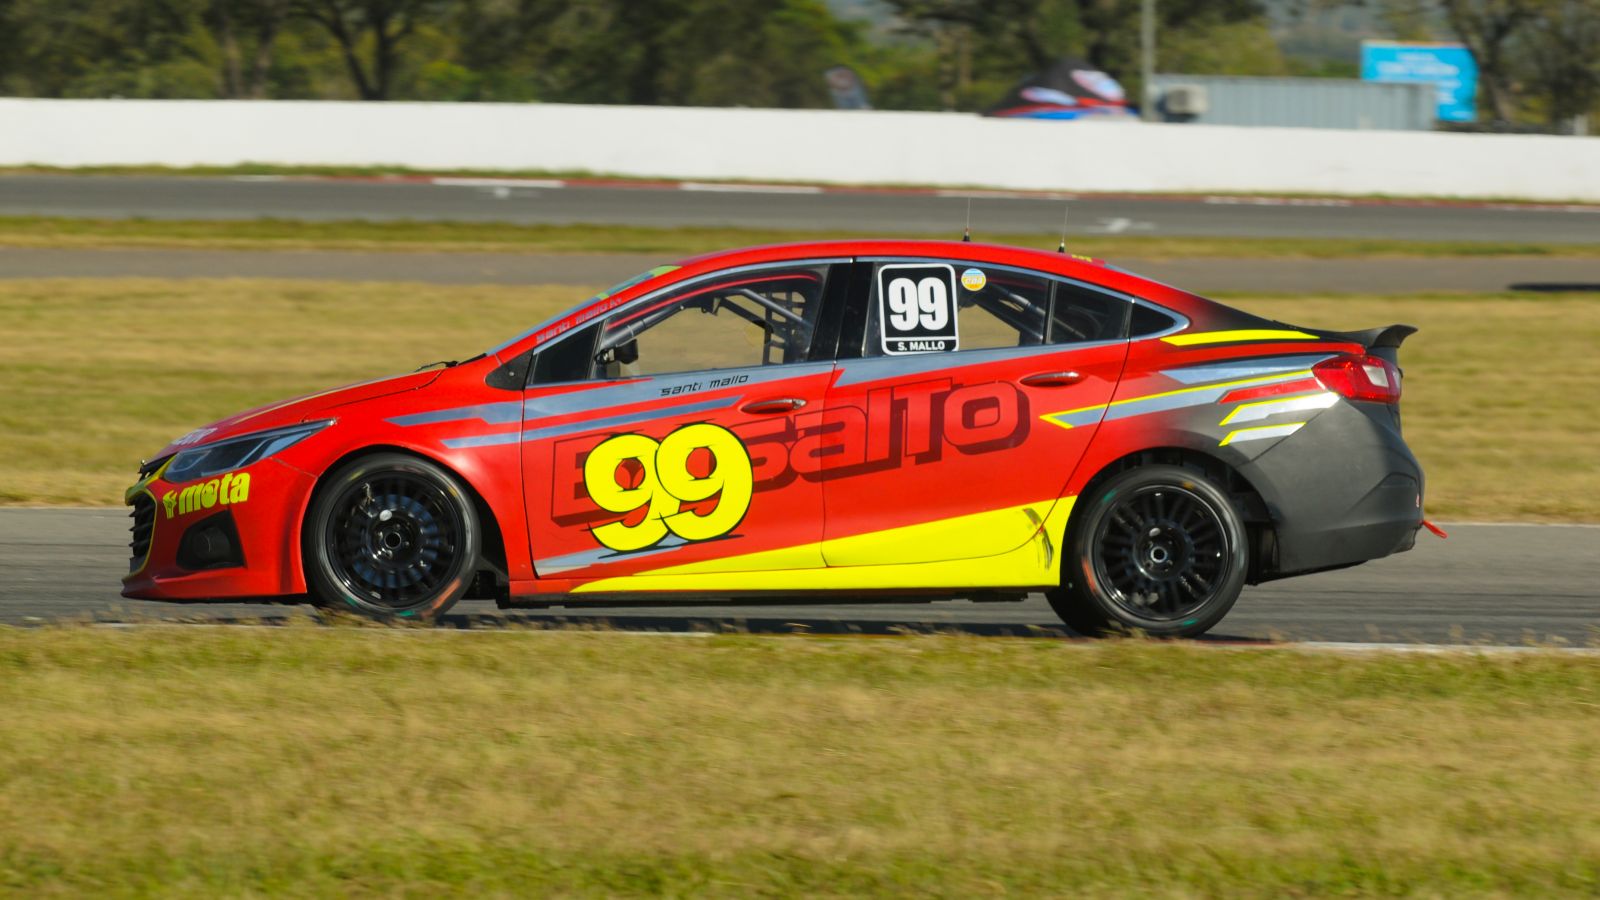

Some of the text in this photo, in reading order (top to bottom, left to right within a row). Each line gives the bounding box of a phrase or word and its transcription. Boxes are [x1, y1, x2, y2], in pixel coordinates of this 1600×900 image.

[888, 277, 948, 331] 99
[897, 341, 945, 351] S. MALLO
[660, 375, 749, 397] santi mallo
[178, 472, 251, 515] mota
[583, 422, 755, 556] 99
